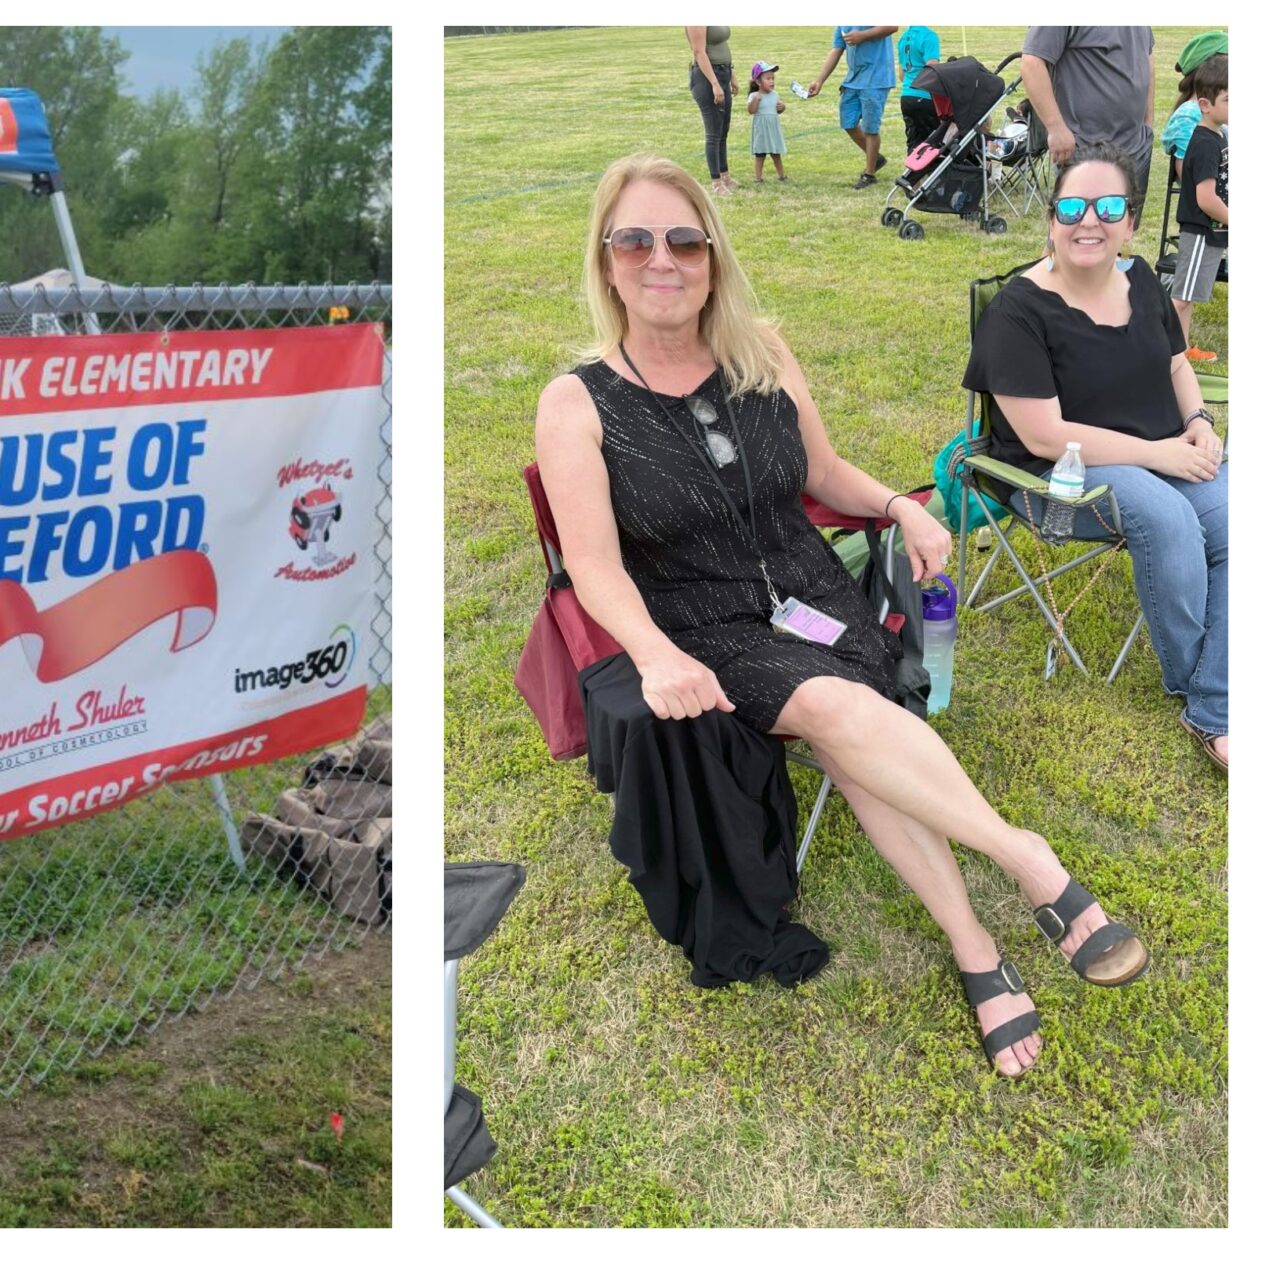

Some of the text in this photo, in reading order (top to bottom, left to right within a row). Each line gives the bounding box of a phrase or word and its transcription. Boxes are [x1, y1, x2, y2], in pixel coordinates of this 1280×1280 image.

[39, 347, 274, 398] ELEMENTARY
[126, 418, 208, 491] OF
[277, 457, 354, 488] Whetzel's
[234, 640, 348, 693] image360
[67, 684, 147, 732] Shuler
[30, 749, 44, 761] OF
[52, 722, 148, 754] COSMETOLOGY
[24, 775, 135, 828] Soccer
[137, 733, 268, 793] Spnsors
